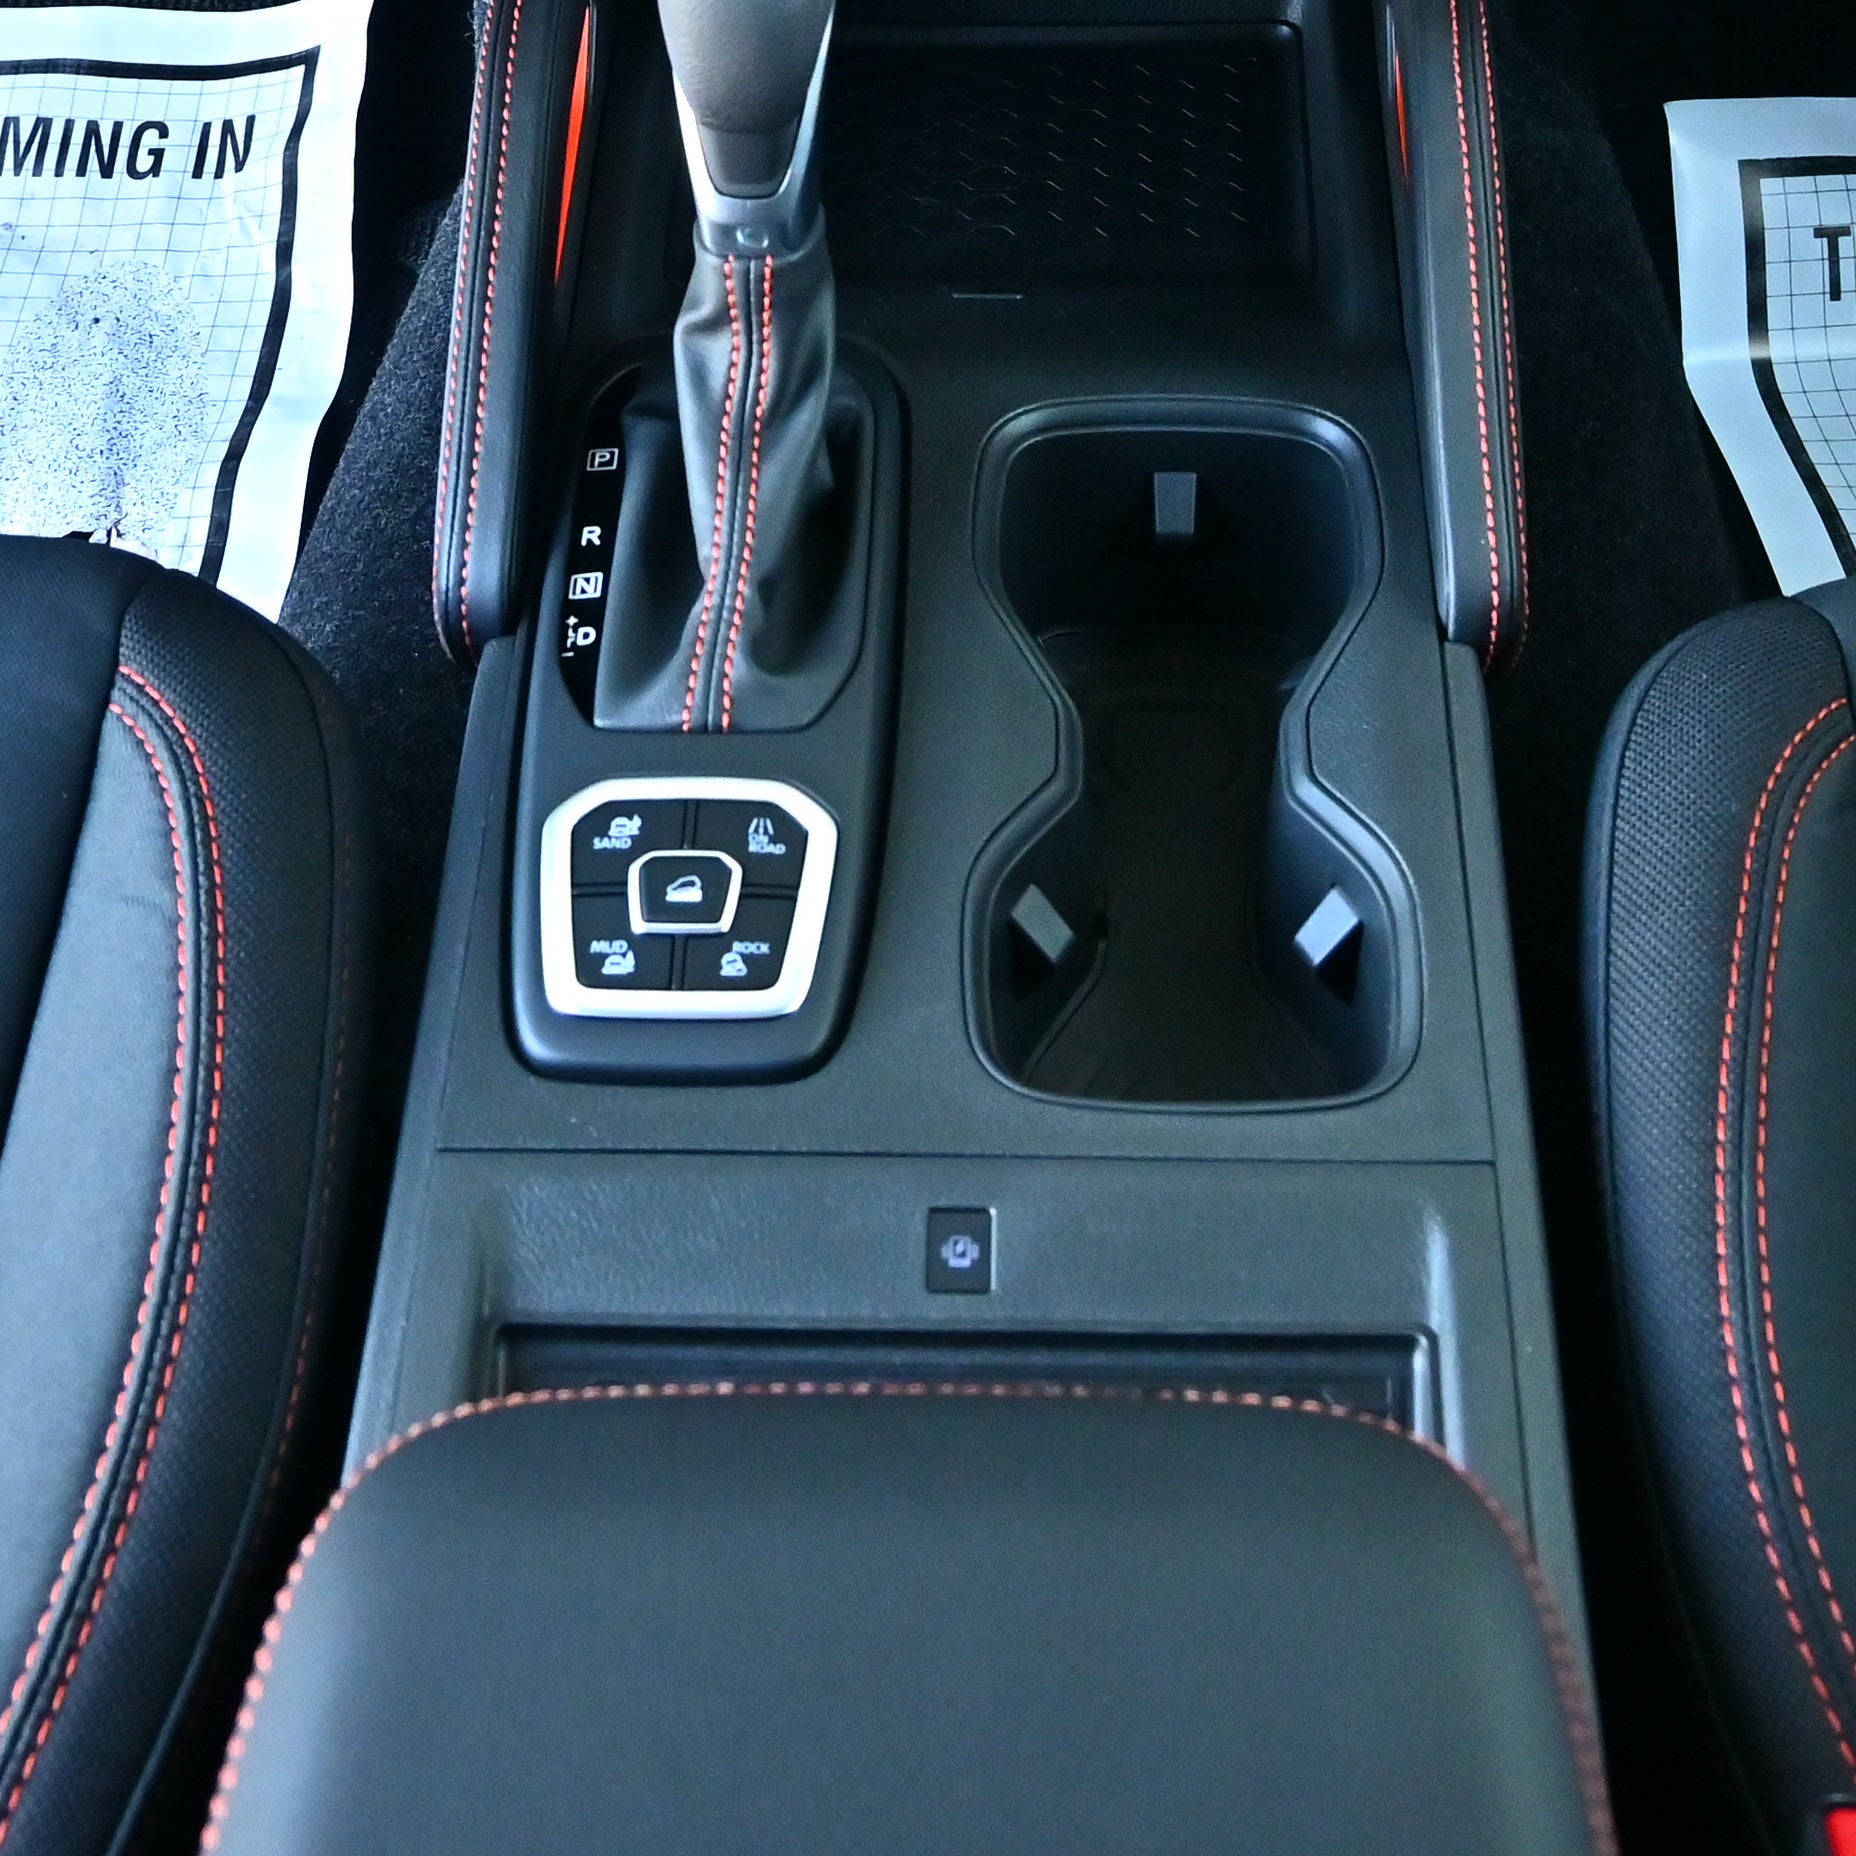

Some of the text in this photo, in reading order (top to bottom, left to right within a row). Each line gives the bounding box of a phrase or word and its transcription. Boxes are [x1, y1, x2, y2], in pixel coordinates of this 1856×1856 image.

[191, 114, 256, 180] IN
[594, 452, 611, 468] P
[581, 526, 601, 546] R
[575, 576, 596, 594] N
[576, 626, 596, 647] D
[592, 837, 632, 850] SAND
[748, 843, 786, 855] ROAD
[590, 940, 628, 954] MUD
[732, 941, 770, 955] ROCK
